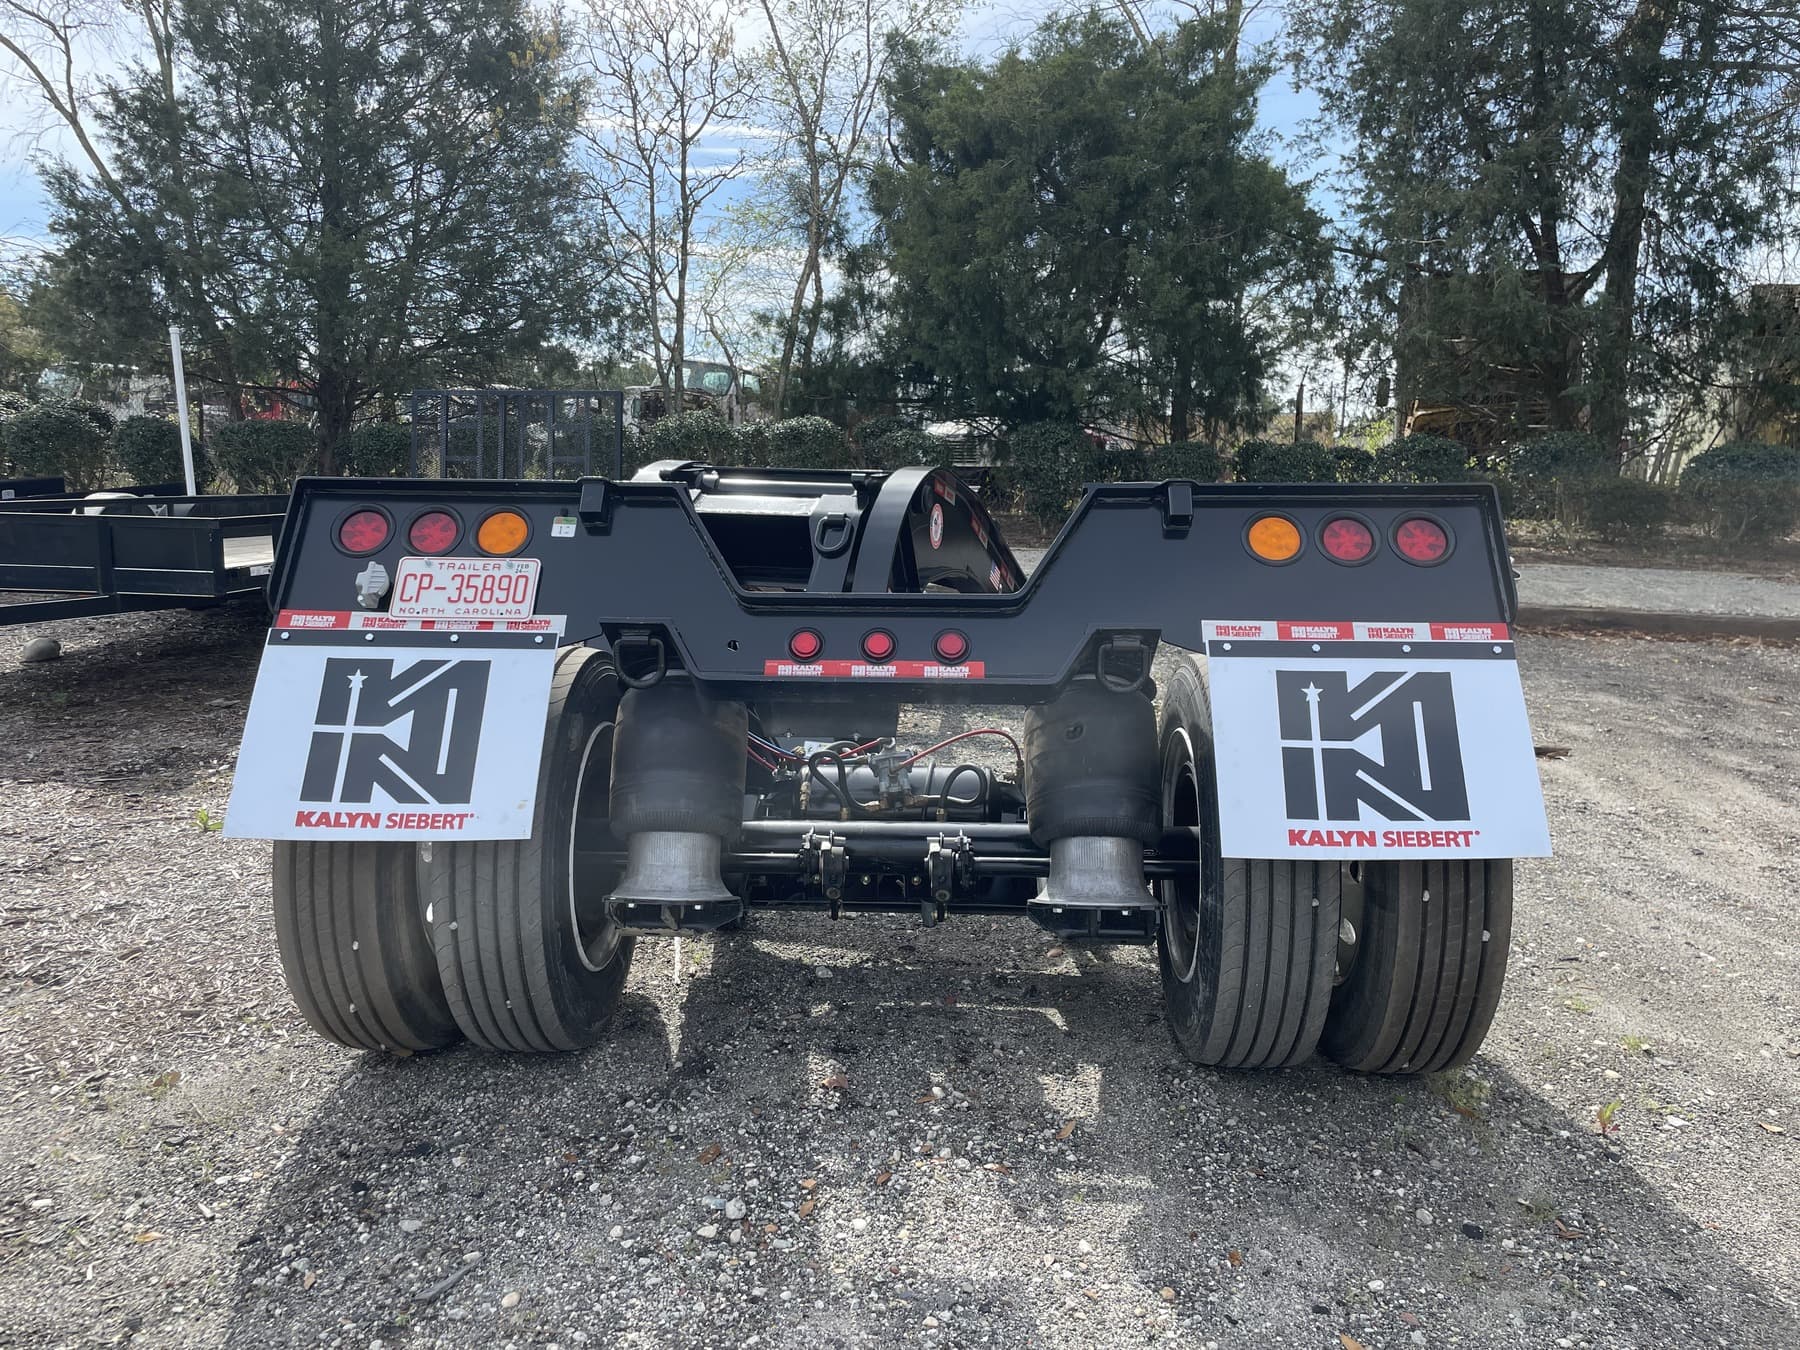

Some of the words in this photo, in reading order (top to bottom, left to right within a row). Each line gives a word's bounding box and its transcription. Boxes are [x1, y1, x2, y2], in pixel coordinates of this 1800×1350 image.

[438, 562, 502, 571] TRAILER
[400, 573, 529, 604] CP-35890
[399, 607, 445, 615] NORTH
[455, 608, 521, 616] CAROLINA
[295, 811, 381, 829] KALYN
[385, 812, 469, 830] SIEBERT
[1288, 828, 1377, 847] KALYN
[1383, 830, 1475, 848] SIEBERT
